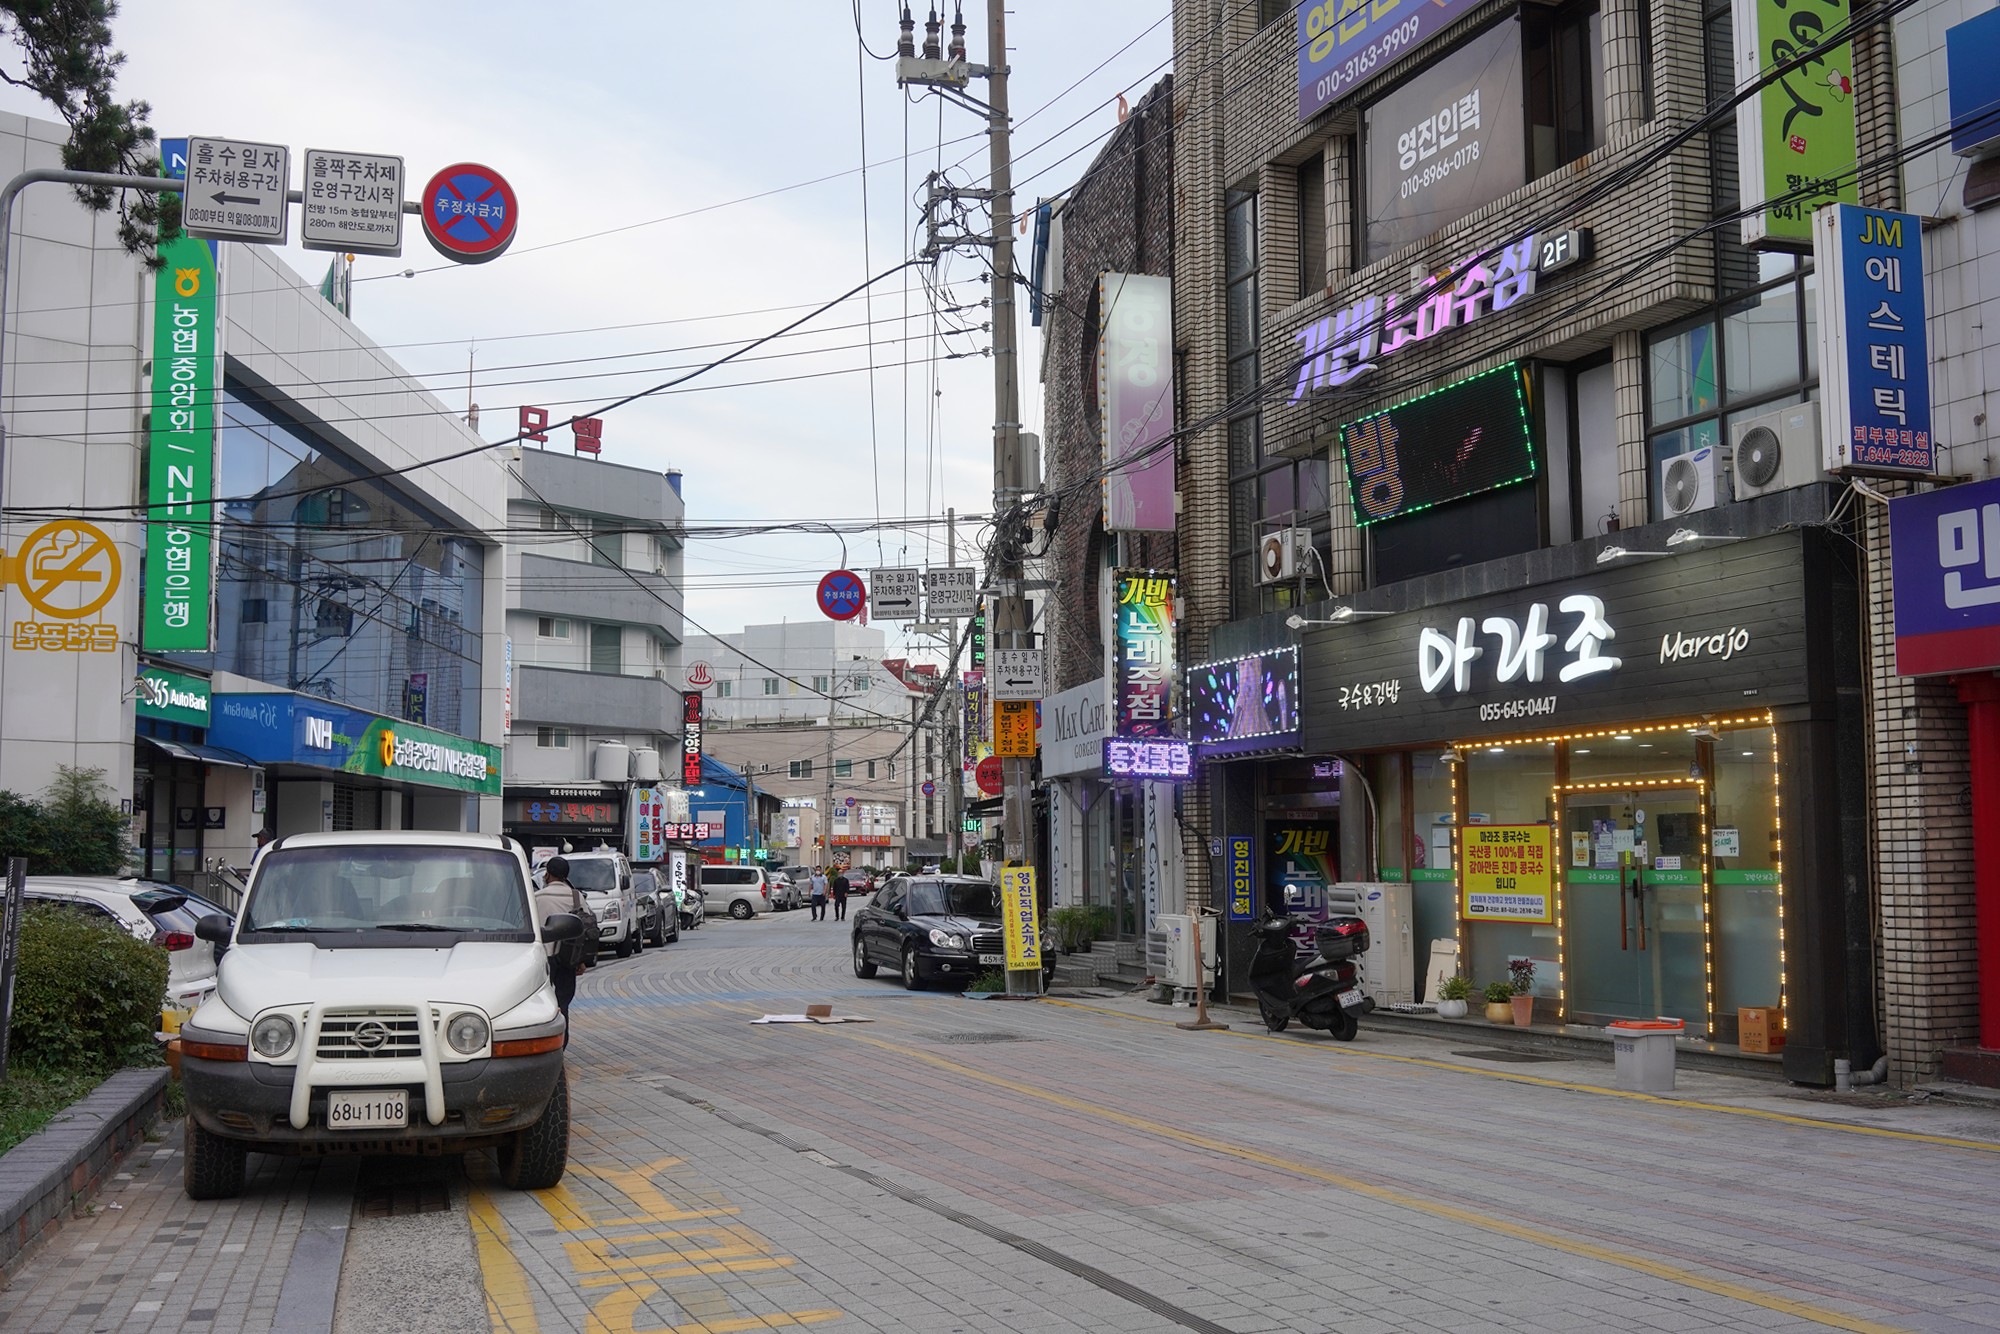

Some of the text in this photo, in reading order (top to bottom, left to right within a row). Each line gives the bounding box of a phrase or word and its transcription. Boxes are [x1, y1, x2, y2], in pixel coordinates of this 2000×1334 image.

[1316, 15, 1420, 101] 010-3163-9909
[1397, 88, 1481, 171] 영진인력
[197, 143, 280, 171] 홀수일자
[312, 156, 395, 182] 홀짝주차제
[1401, 140, 1480, 199] 010-8966-0178
[194, 167, 279, 191] 주차허용구간
[311, 181, 395, 204] 운영구간시작
[307, 203, 326, 214] 전방
[329, 206, 348, 215] 15m
[437, 197, 504, 220] 주정차금지
[309, 218, 336, 228] 280m
[1859, 215, 1903, 248] JM
[1287, 296, 1379, 407] 가빈
[1543, 235, 1567, 268] 2F
[1864, 257, 1907, 426] 에스테틱
[169, 303, 199, 434] 농협중앙회
[518, 405, 603, 454] 모텔
[1854, 426, 1928, 449] 피부관리실
[1855, 446, 1929, 467] T.644-2323
[163, 465, 194, 628] NH농협은행
[873, 585, 917, 596] 주차허용구간
[930, 573, 974, 587] 홀짝주차제
[1119, 577, 1170, 607] 가빈
[825, 590, 860, 600] 주정차금지
[930, 590, 974, 604] 운영구간시작
[1417, 593, 1623, 694] 마라조
[1659, 626, 1750, 666] Marajo
[996, 665, 1040, 677] 주차허용구간
[1001, 652, 1039, 665] 홀수일자
[1126, 611, 1163, 721] 노래주점
[170, 688, 208, 712] AutoBank
[1338, 682, 1401, 712] 국수&김밥
[305, 716, 333, 750] NH
[1054, 704, 1078, 743] MAX
[528, 802, 612, 822] 용궁 뚝배기
[639, 789, 650, 859] 아이스크림
[664, 823, 709, 839] 할인점
[1275, 829, 1330, 856] 가빈
[1502, 831, 1531, 843] 콩국수는
[1468, 845, 1544, 859] 국산콩 100%를 직접
[1233, 840, 1251, 916] 영진인력
[1468, 861, 1544, 875] 갈아만든 진짜 콩국수
[1495, 877, 1517, 889] 입니다
[1017, 872, 1036, 959] 영진직업소개소
[331, 1101, 405, 1122] 68나1108
